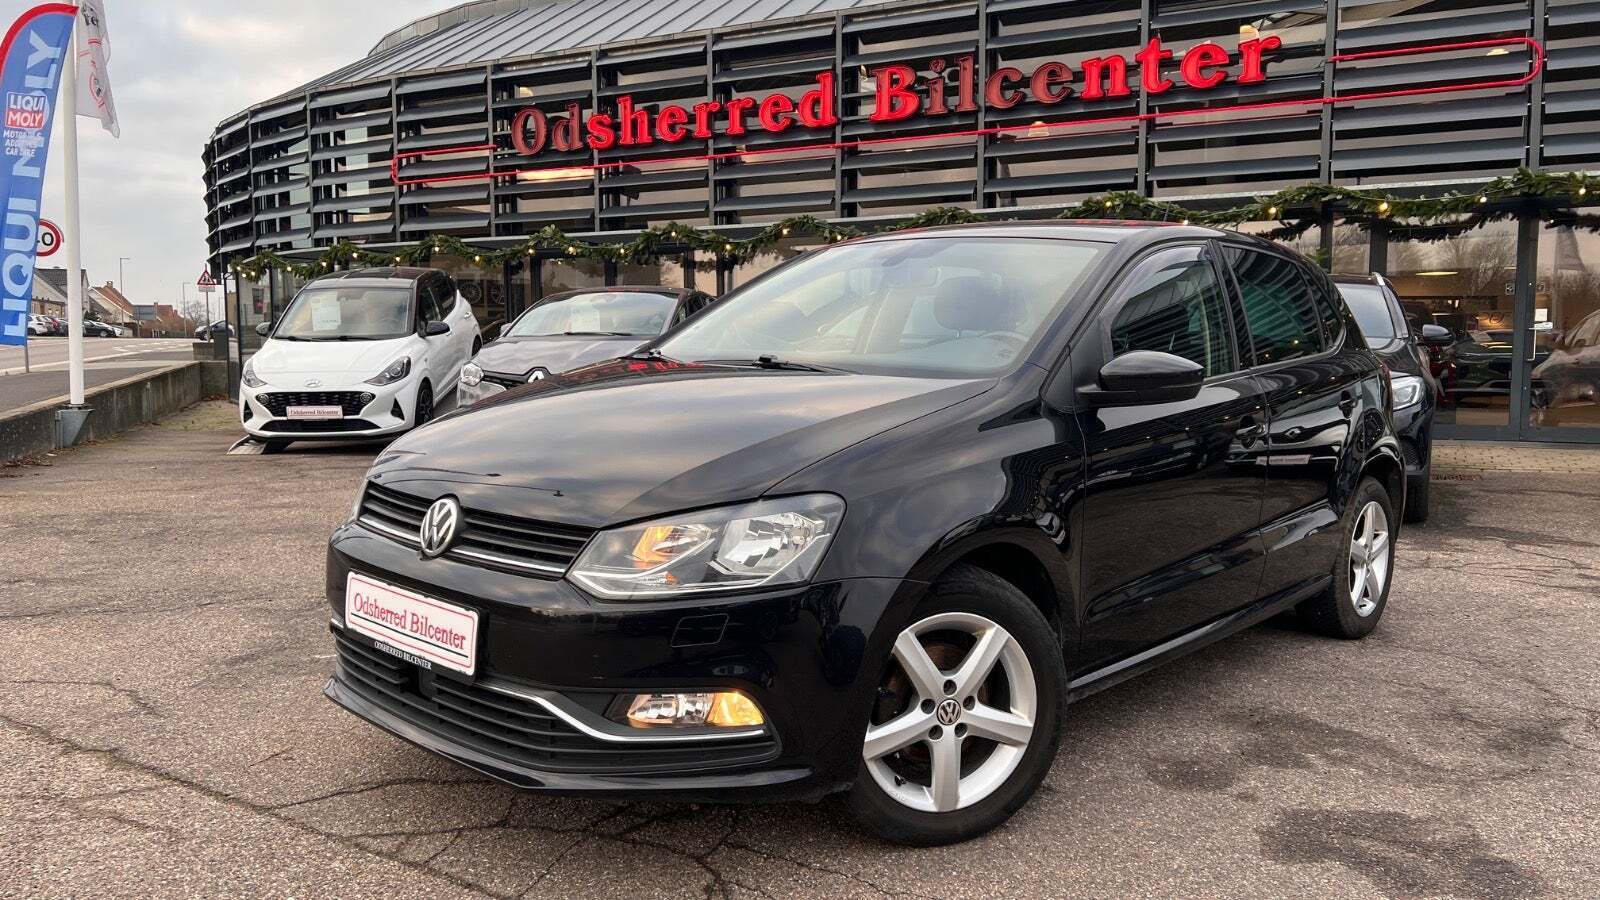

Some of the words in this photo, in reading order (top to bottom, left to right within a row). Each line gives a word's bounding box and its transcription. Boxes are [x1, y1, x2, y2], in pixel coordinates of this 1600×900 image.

[9, 94, 44, 112] LIQUI
[511, 70, 838, 156] Odsherred
[869, 35, 1283, 123] Bilcenter
[7, 111, 42, 127] MOLY
[2, 197, 37, 337] LIQUI
[353, 592, 407, 630] Odsherred
[409, 611, 467, 650] Bilcenter
[403, 653, 433, 671] BILCENTER
